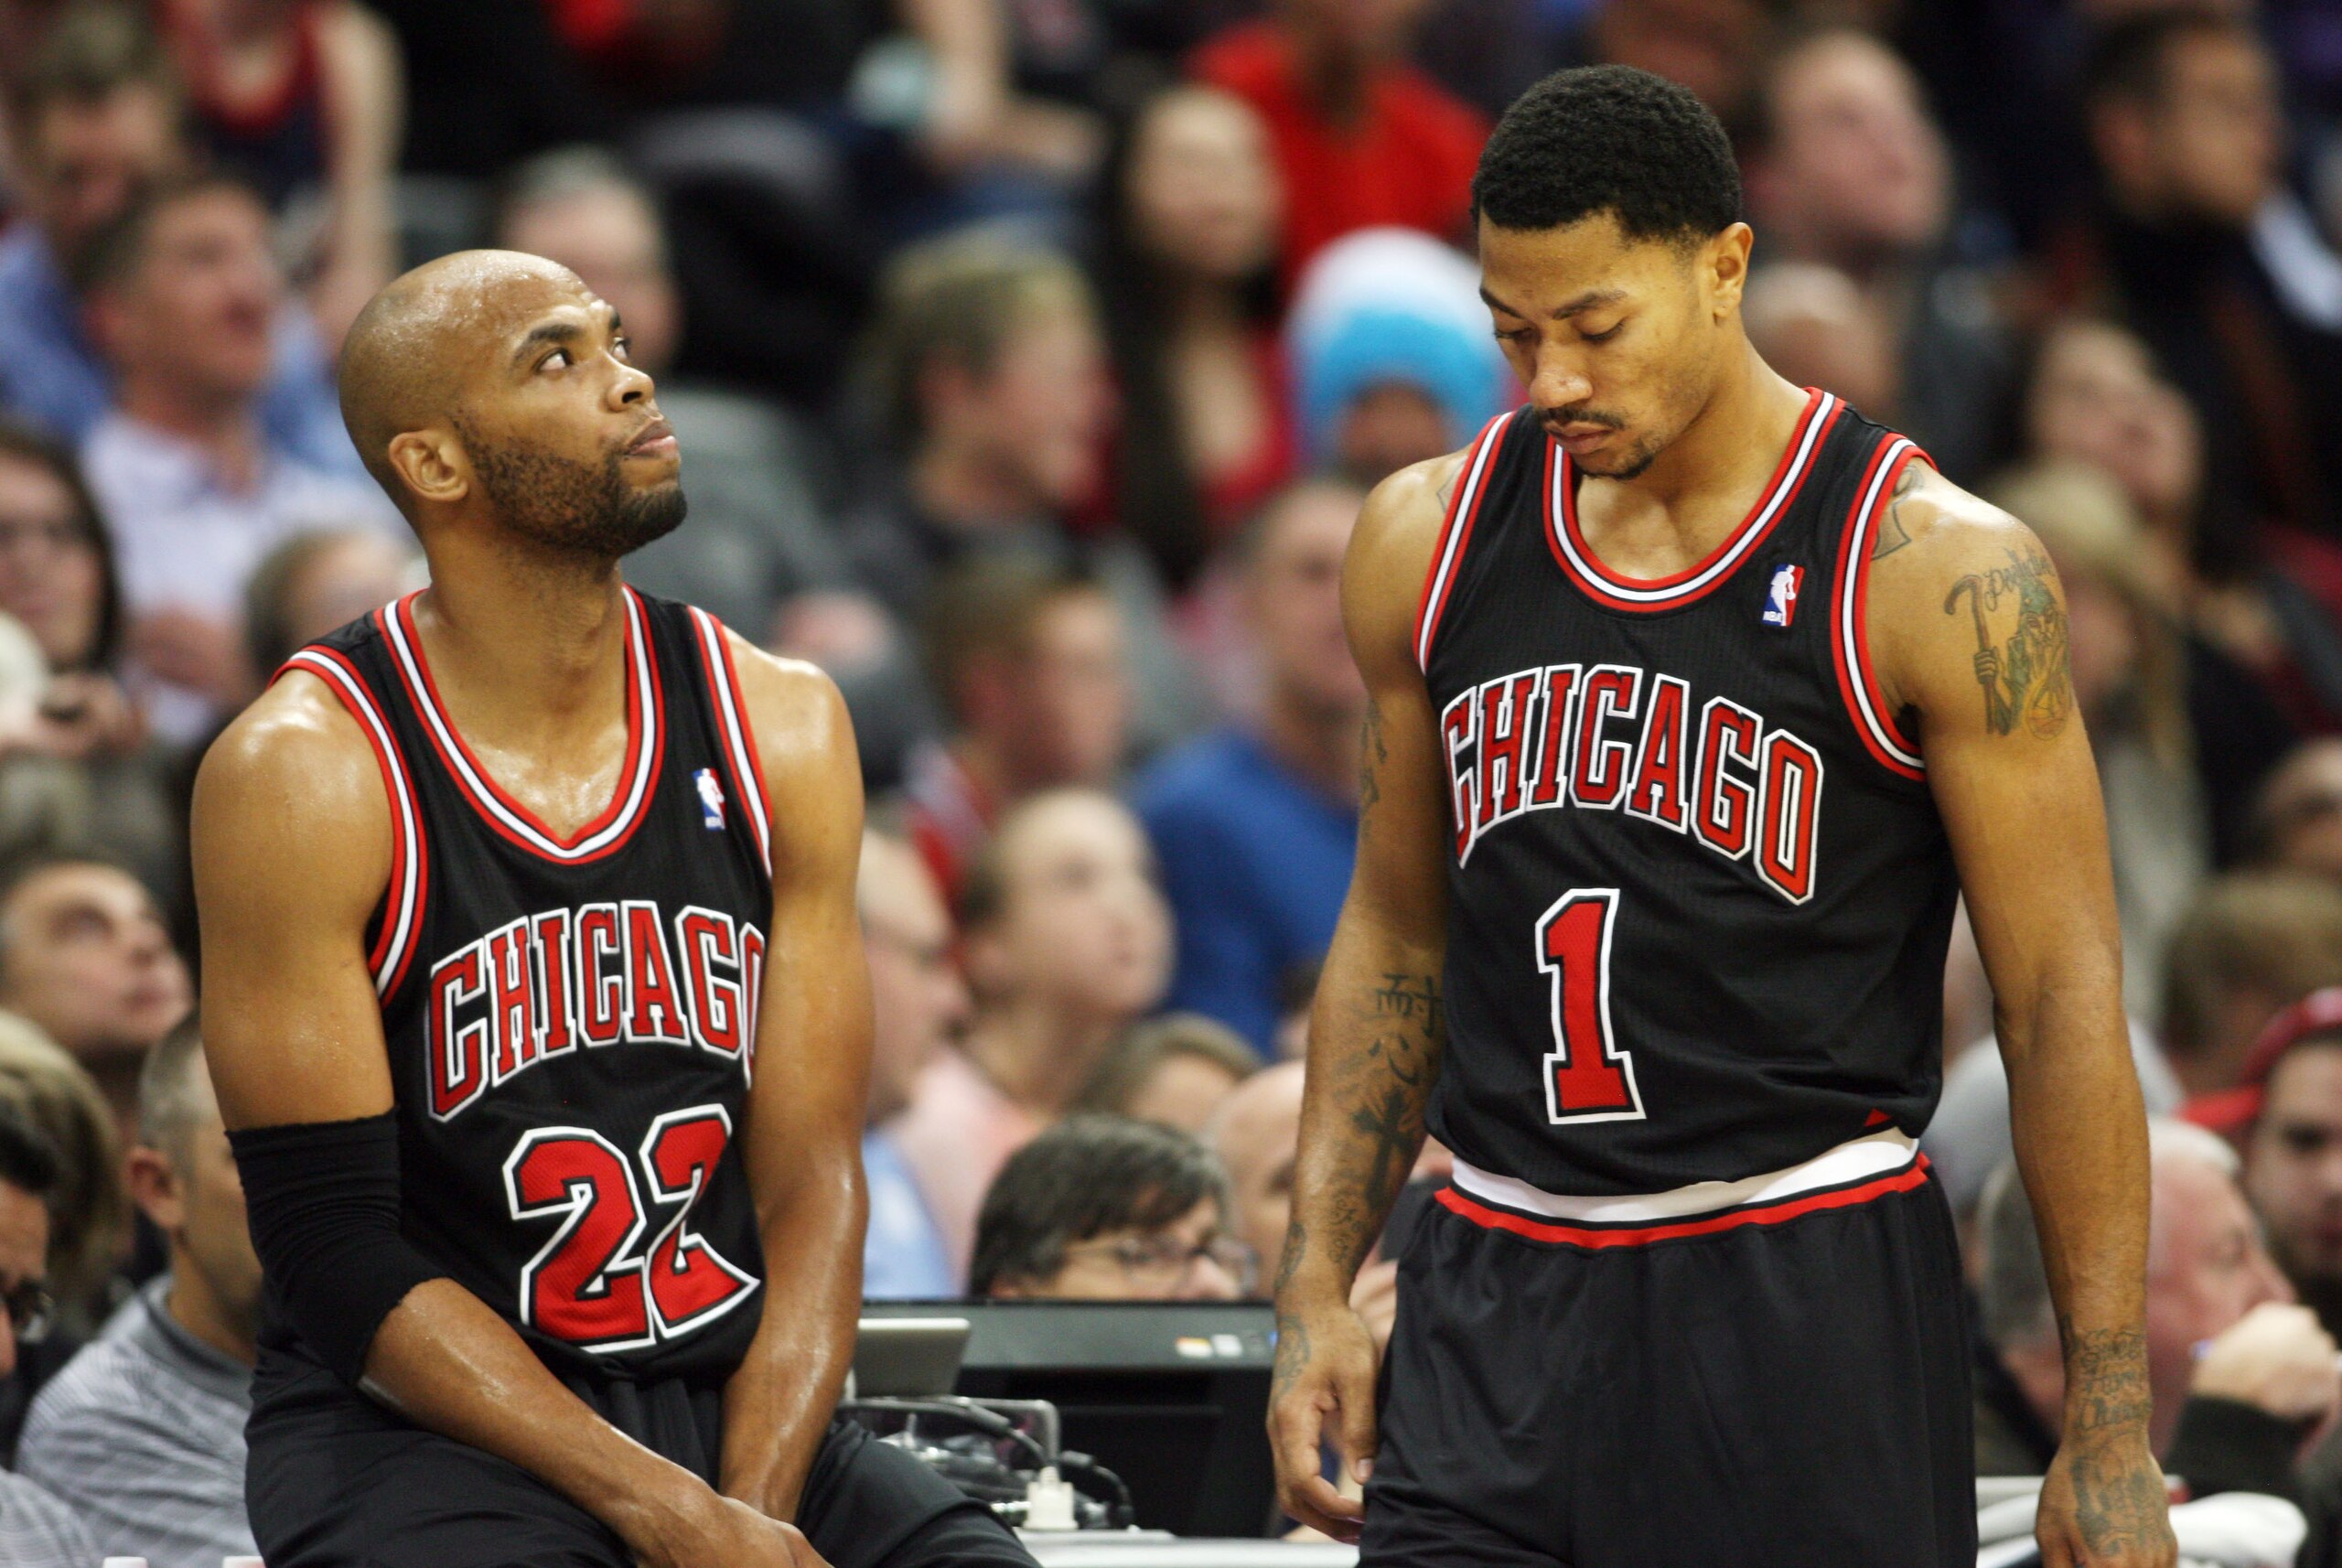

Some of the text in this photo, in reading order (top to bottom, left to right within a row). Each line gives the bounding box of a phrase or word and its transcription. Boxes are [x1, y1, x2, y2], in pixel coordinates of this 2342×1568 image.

[1441, 663, 1823, 906] CHICAGO
[1535, 888, 1646, 1124] 1
[503, 1103, 760, 1353] 22
